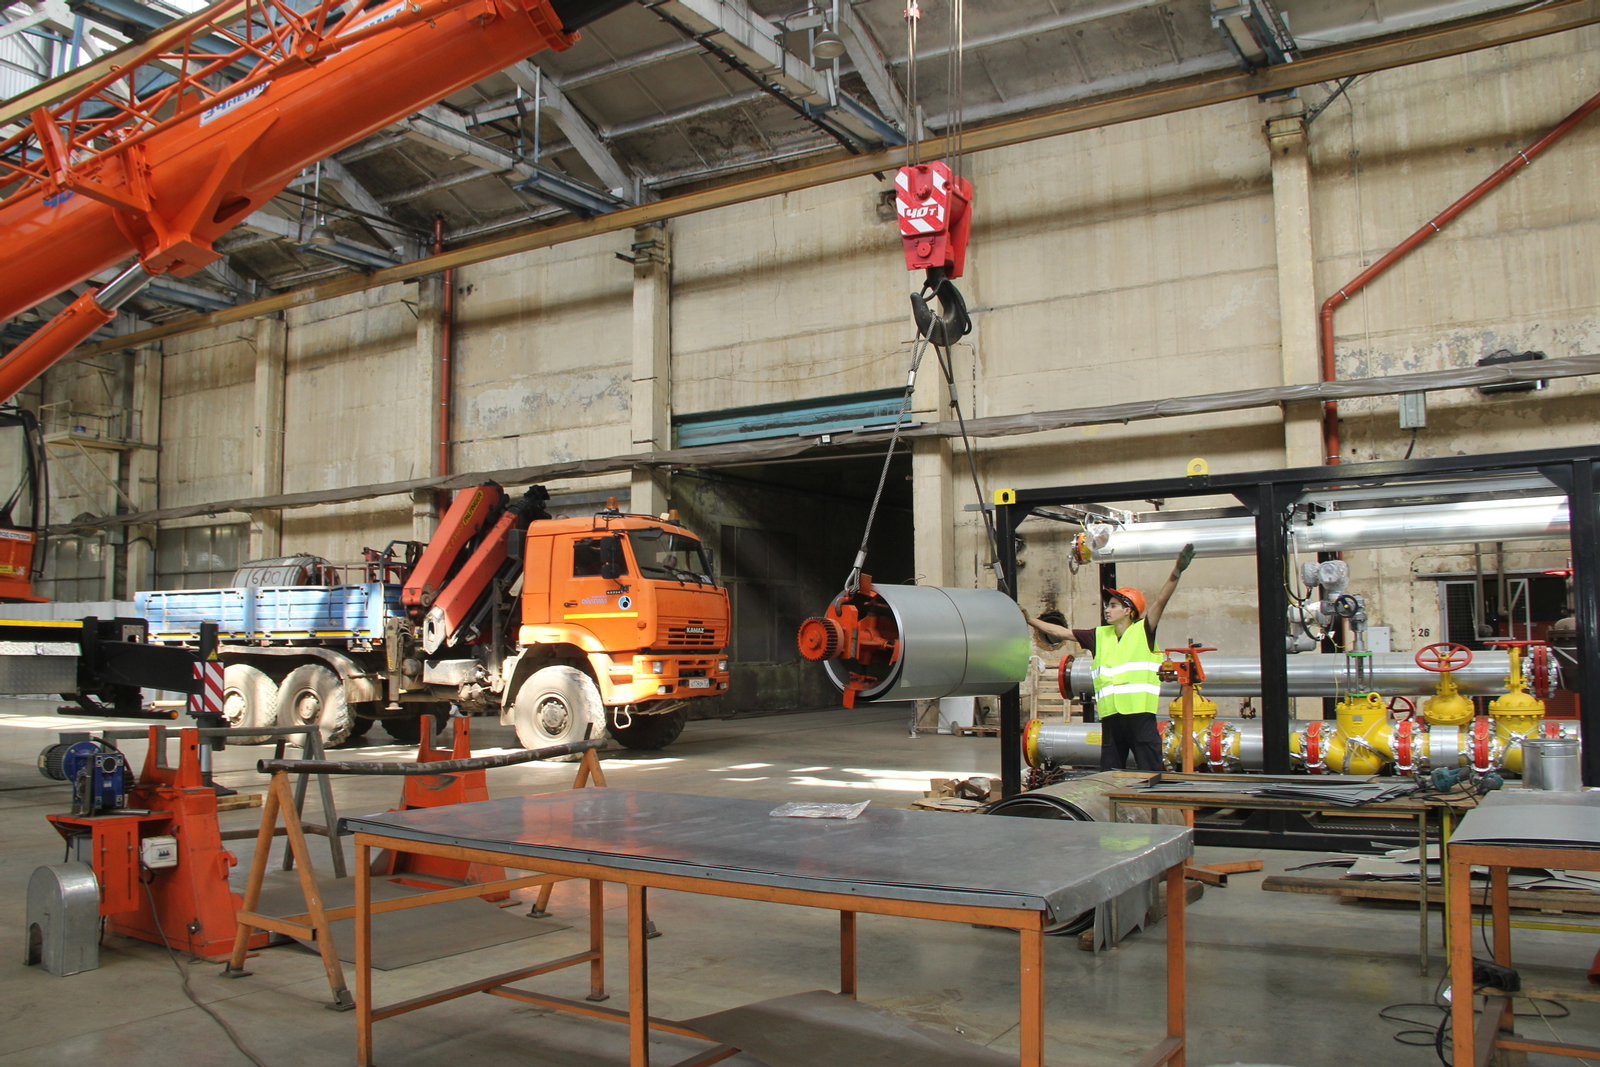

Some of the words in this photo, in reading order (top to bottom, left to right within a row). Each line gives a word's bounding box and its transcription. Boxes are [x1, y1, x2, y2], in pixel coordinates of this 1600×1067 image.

[463, 491, 484, 524] PALFINGER
[252, 568, 282, 585] 600
[686, 626, 705, 634] KAMAZ
[1418, 628, 1430, 637] 26
